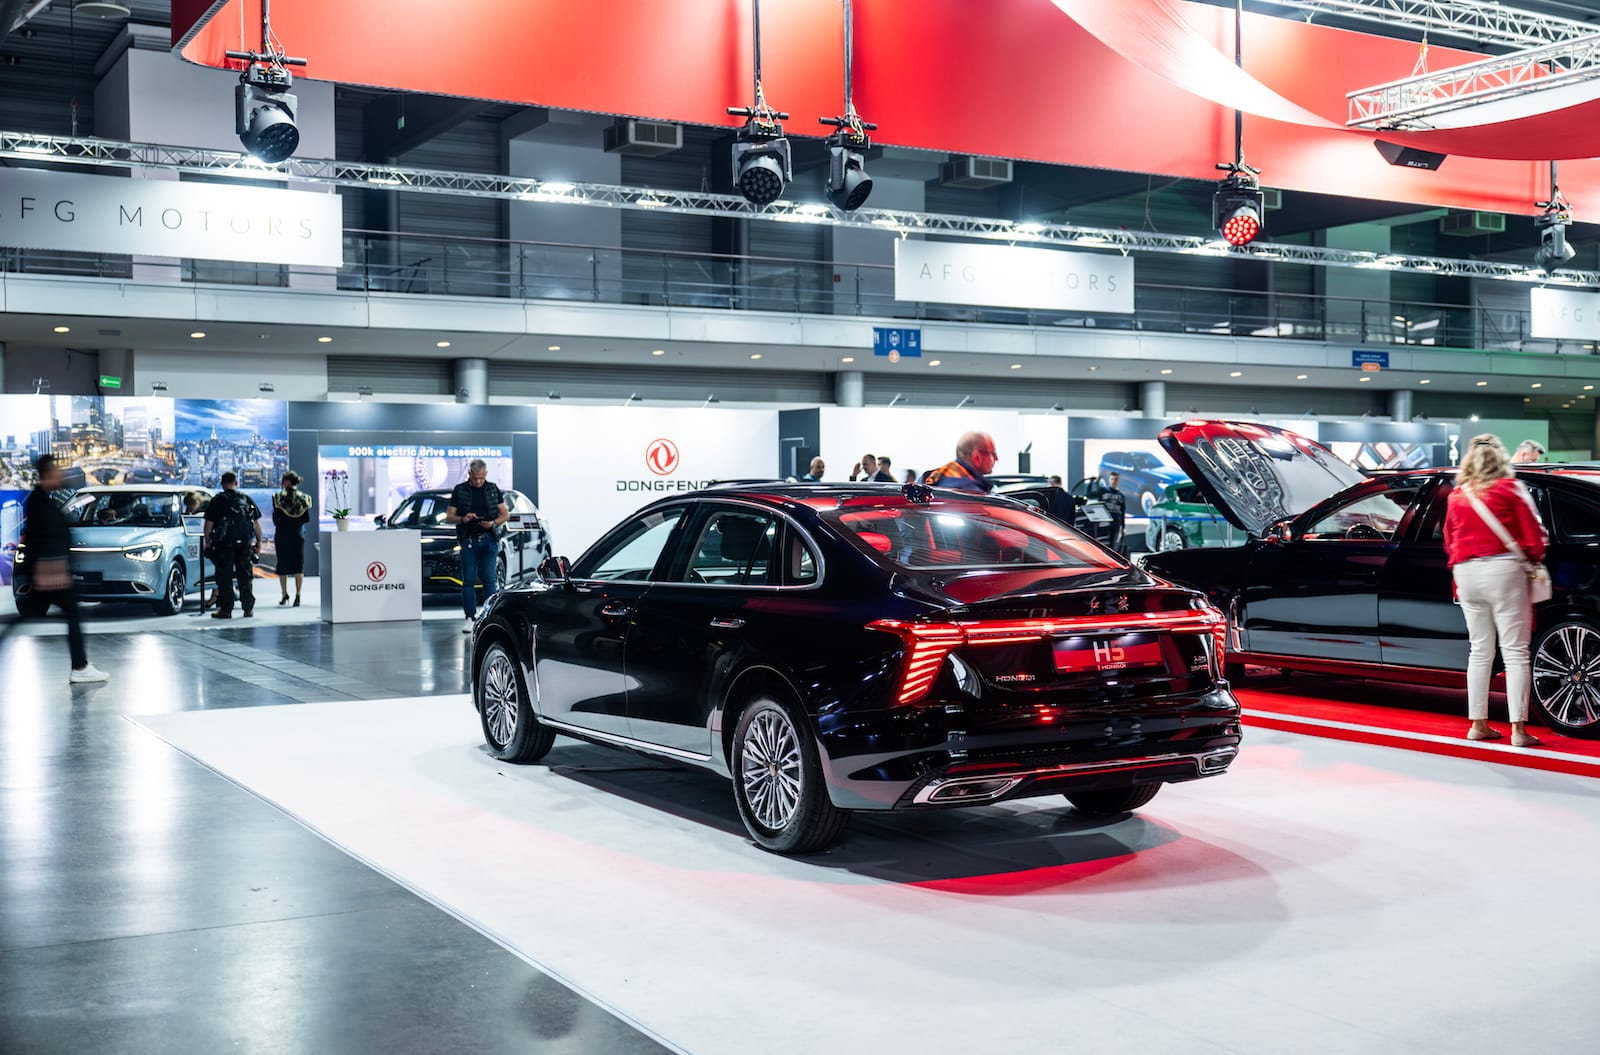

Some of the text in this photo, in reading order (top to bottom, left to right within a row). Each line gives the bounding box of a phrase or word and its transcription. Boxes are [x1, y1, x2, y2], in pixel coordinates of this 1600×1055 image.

[0, 196, 313, 240] FG MOTORS
[919, 263, 978, 283] AFG
[348, 446, 503, 457] 900k electric drive assemblies
[349, 583, 406, 592] DONGFENG
[1092, 639, 1126, 663] H5
[1101, 663, 1127, 671] HONGQI
